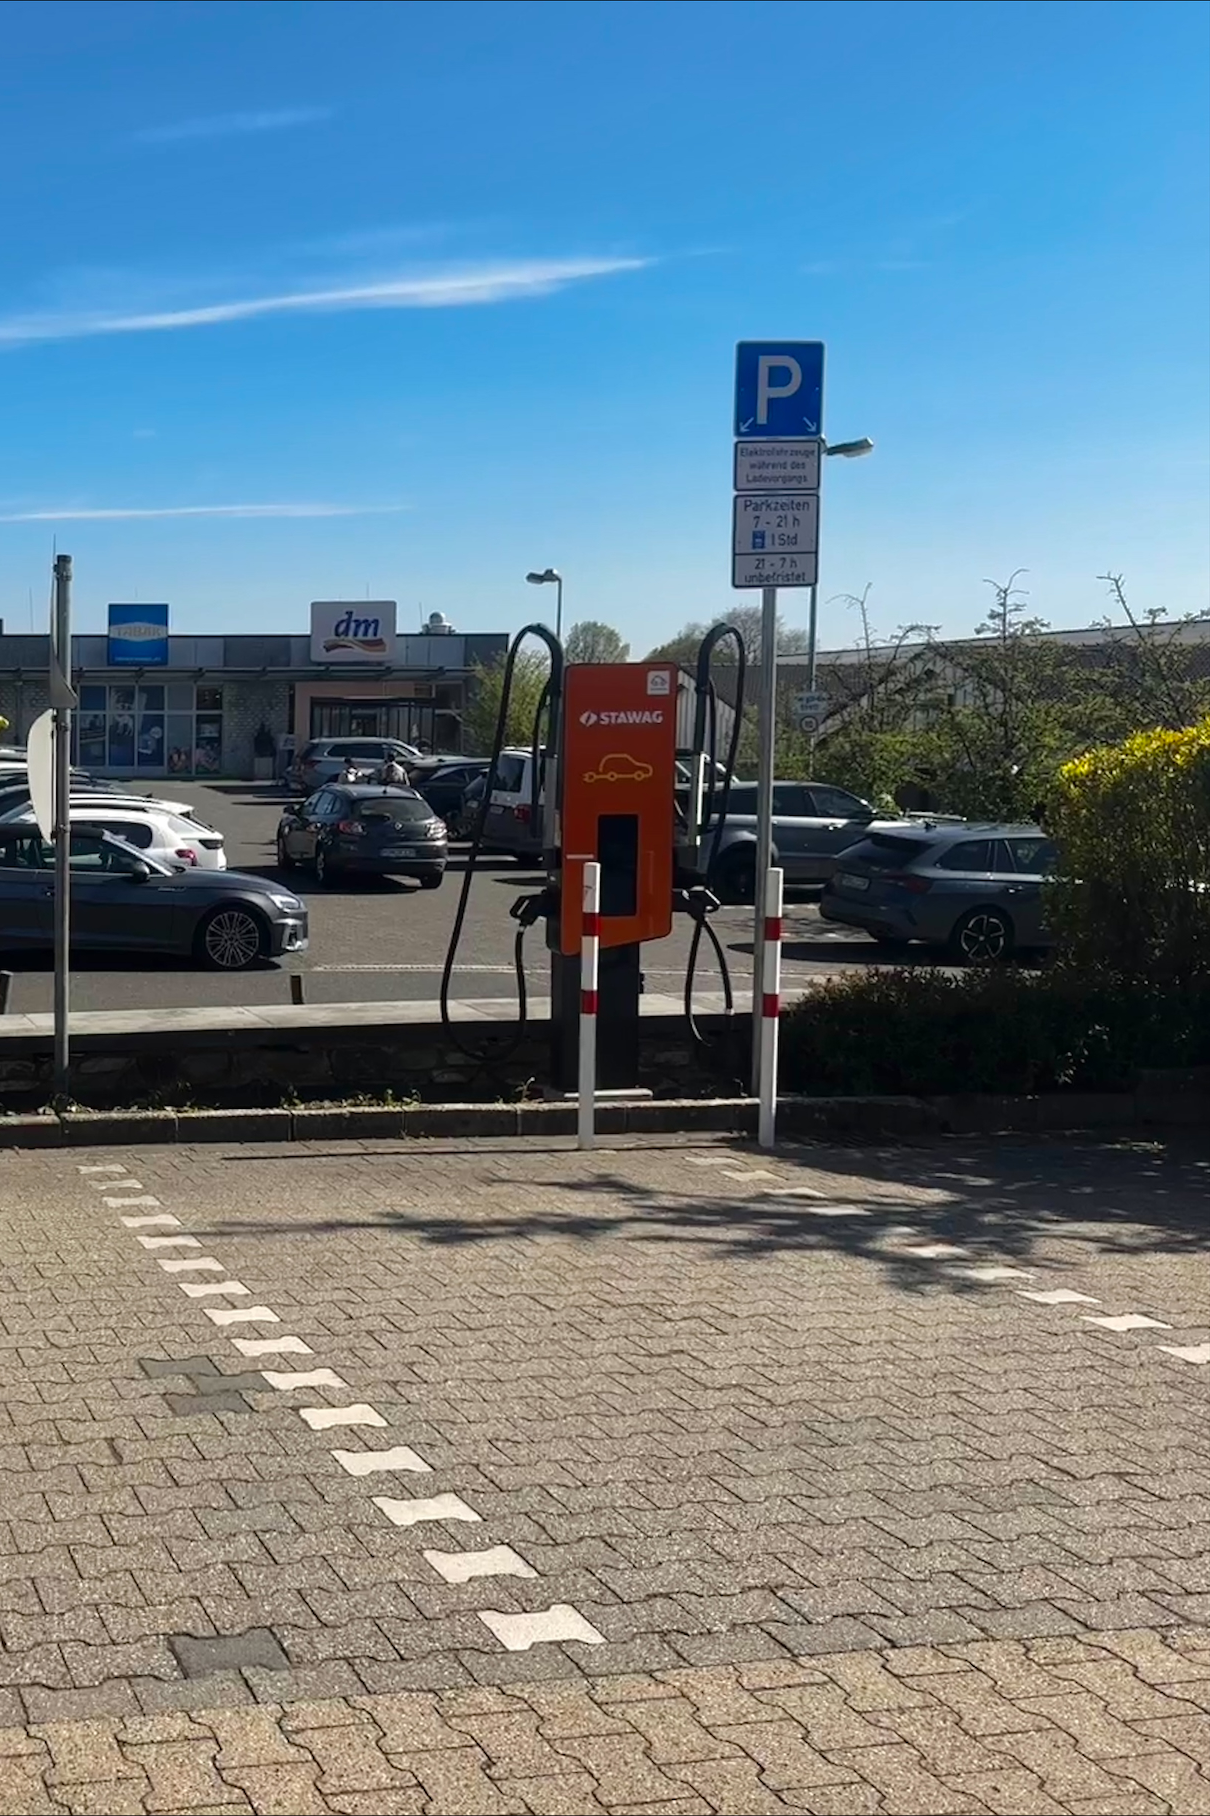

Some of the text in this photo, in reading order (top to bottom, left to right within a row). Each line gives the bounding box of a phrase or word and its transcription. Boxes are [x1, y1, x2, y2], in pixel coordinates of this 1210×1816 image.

[756, 355, 802, 425] P
[791, 461, 806, 470] des
[744, 500, 810, 512] Parkzeiten
[753, 515, 760, 528] 7
[776, 514, 787, 528] 21
[792, 514, 800, 528] h
[755, 558, 765, 569] 21
[780, 557, 787, 569] 7
[790, 557, 797, 569] h
[745, 571, 806, 583] unbefristet
[334, 610, 379, 638] dm
[599, 710, 663, 725] STAWAG
